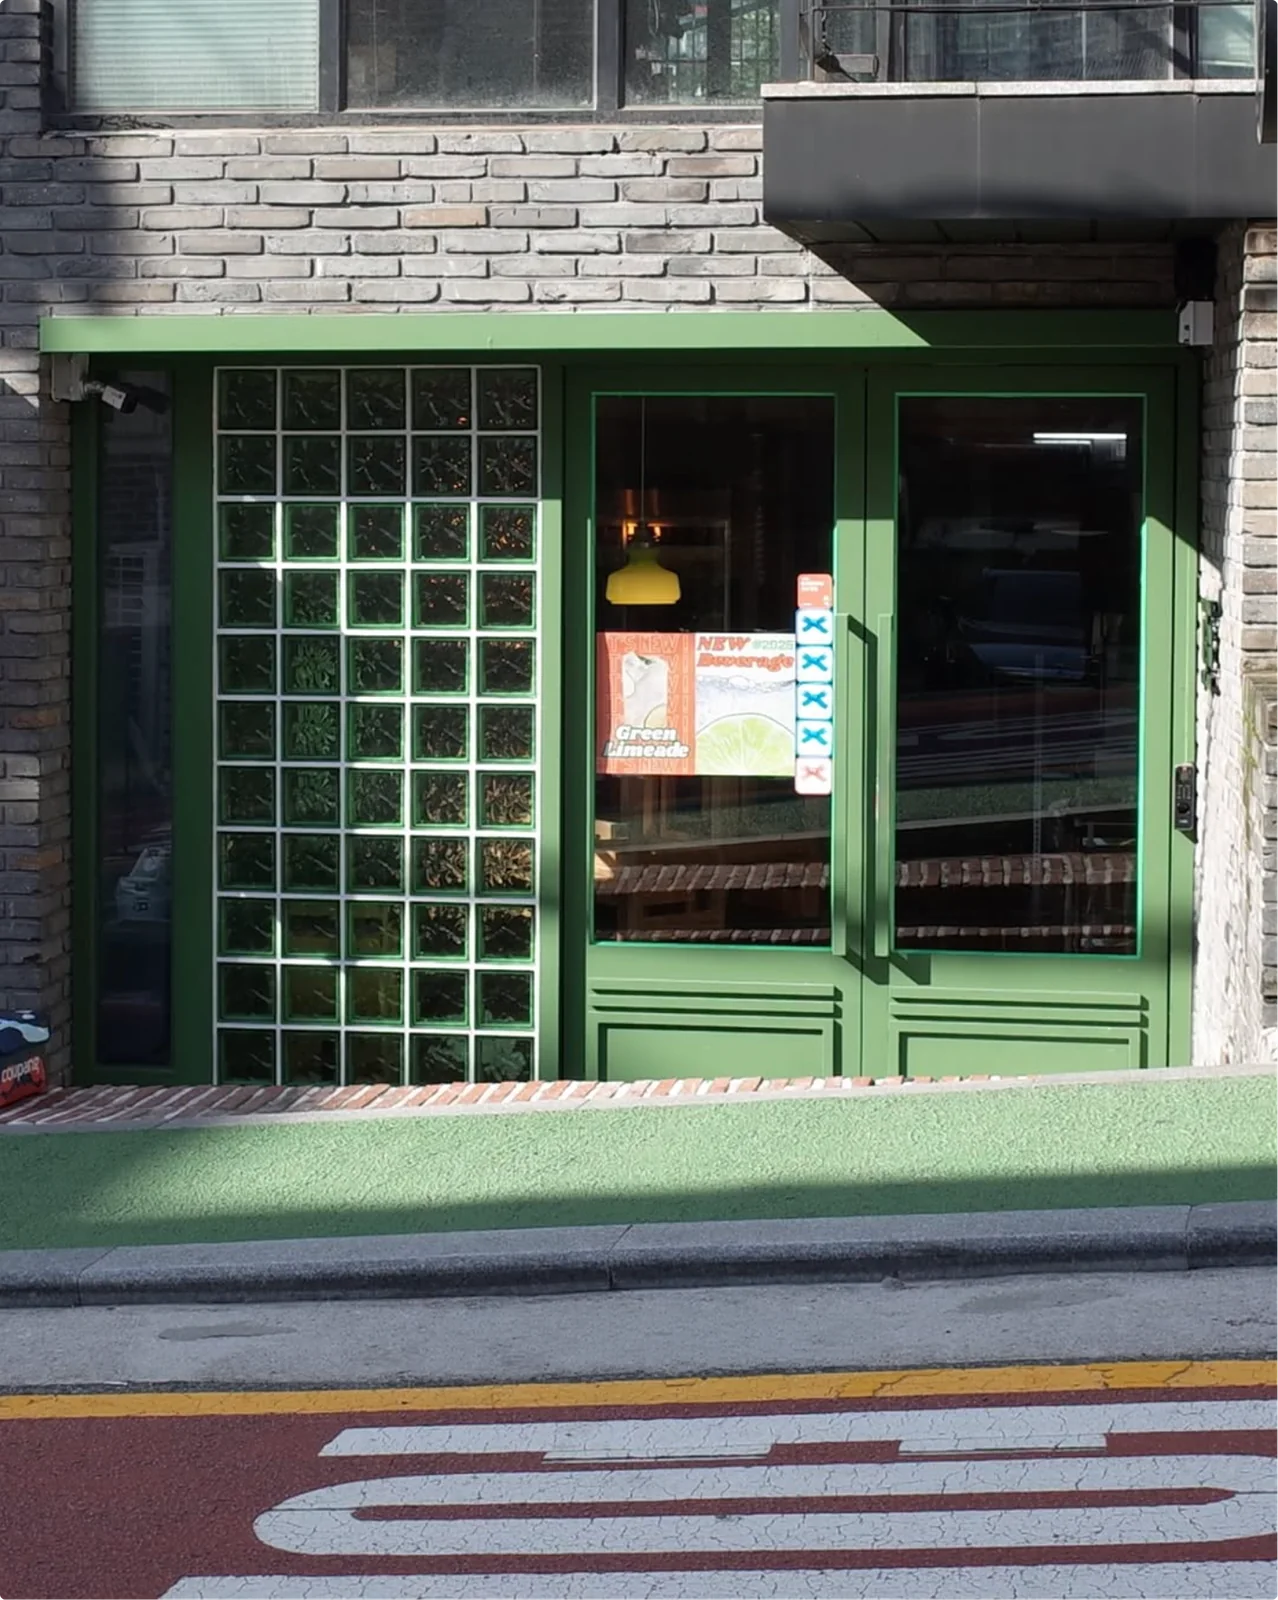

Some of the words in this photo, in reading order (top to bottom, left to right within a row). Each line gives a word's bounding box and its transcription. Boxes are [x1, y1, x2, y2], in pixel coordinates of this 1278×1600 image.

[697, 636, 751, 651] NEW
[615, 725, 677, 741] Green
[603, 741, 690, 757] Limeade
[1, 1056, 40, 1082] coupang
